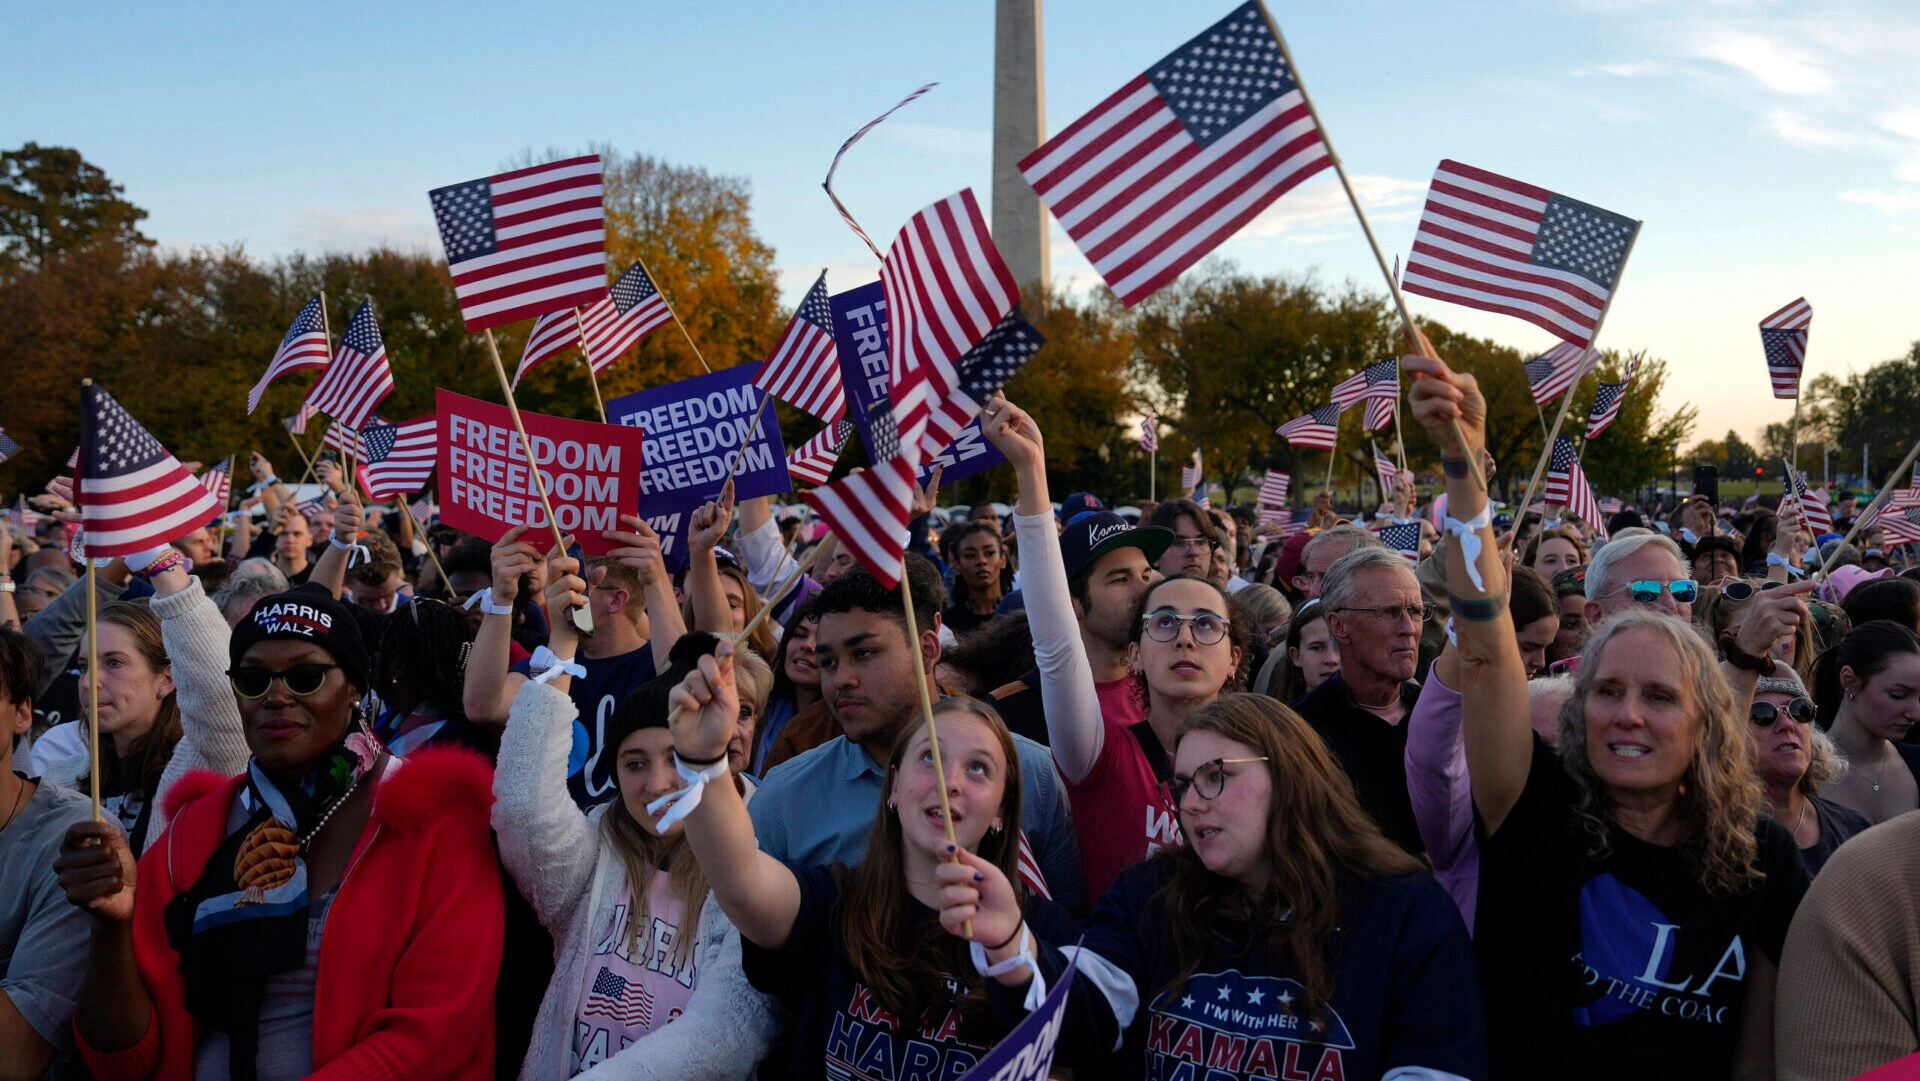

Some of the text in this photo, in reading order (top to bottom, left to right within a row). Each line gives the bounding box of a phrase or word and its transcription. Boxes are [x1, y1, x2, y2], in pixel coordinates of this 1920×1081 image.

[450, 413, 621, 473] FREEDOM
[642, 413, 767, 467] REEDOM
[450, 445, 619, 504] FREEDOM
[639, 443, 776, 496] FREEDOM
[451, 476, 617, 532] FREEDOM
[254, 603, 333, 628] HARRIS
[266, 620, 314, 637] WALZ
[1203, 1001, 1299, 1029] I'M WITH HER
[1605, 976, 1657, 1010] THE
[1147, 1014, 1346, 1081] KAMALA
